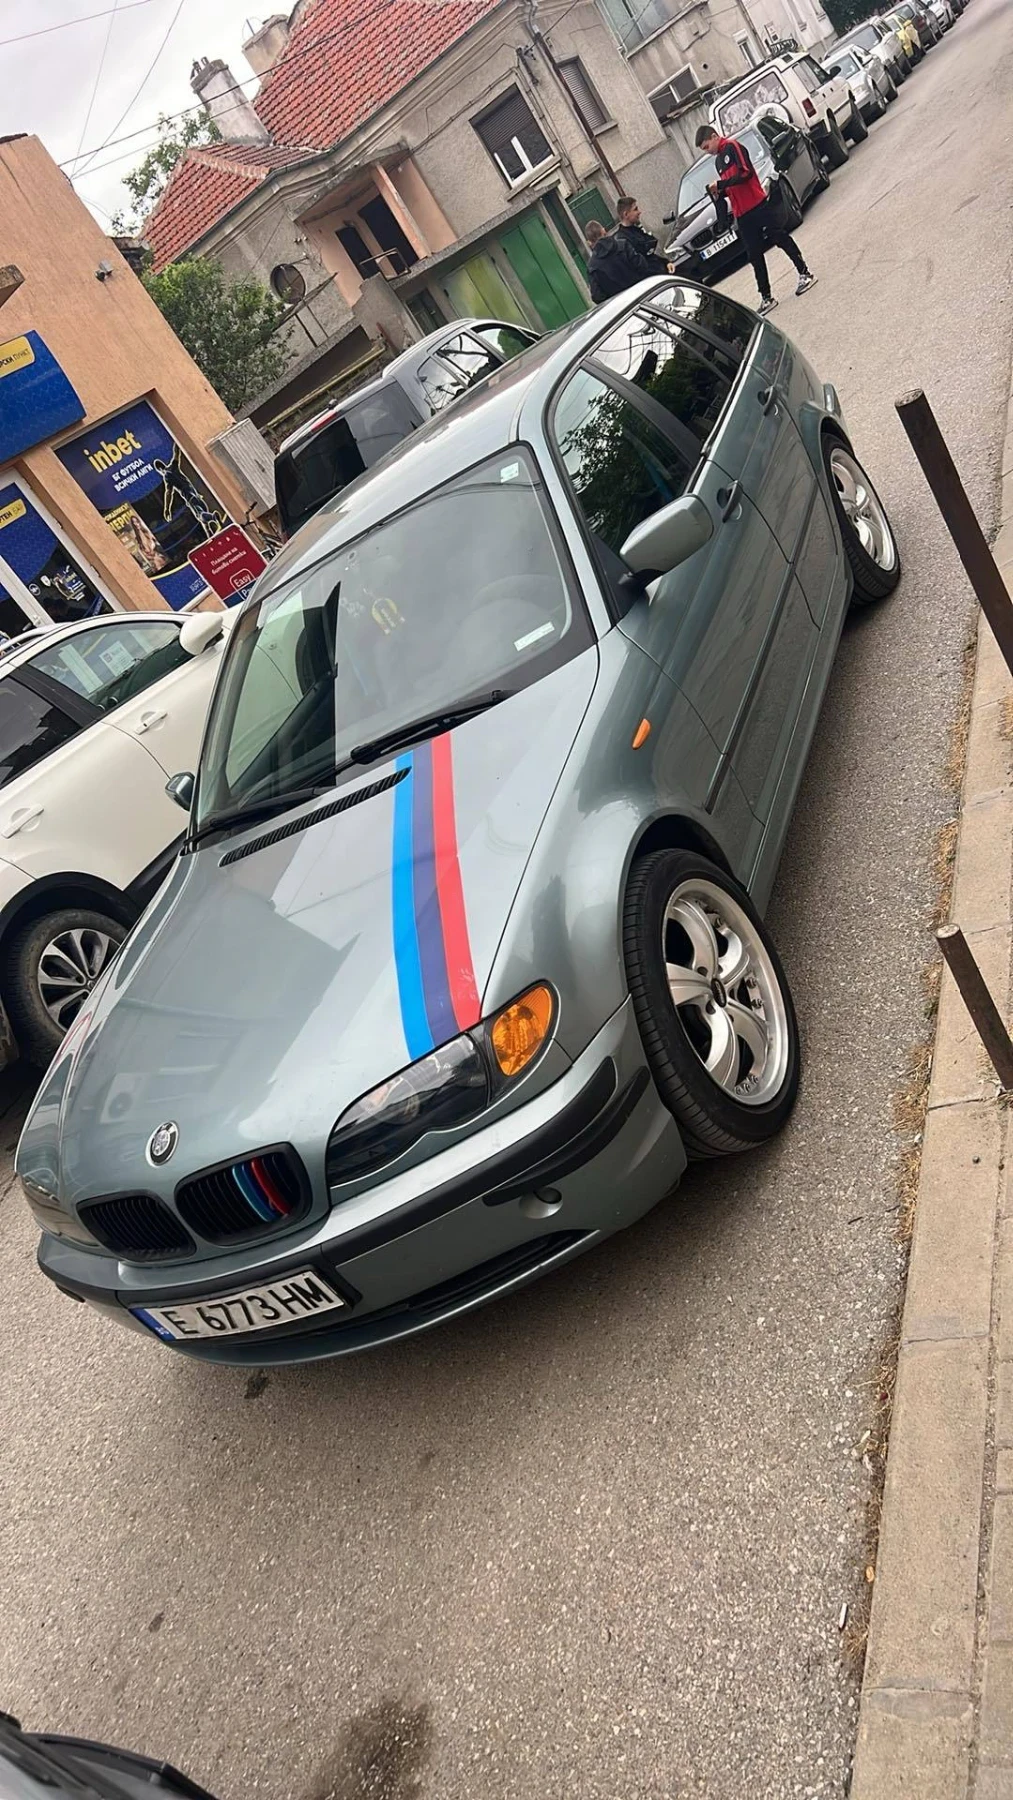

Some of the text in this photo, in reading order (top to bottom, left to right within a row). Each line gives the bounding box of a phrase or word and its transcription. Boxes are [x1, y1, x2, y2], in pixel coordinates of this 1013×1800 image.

[83, 429, 142, 473] inbet
[120, 458, 145, 477] ФУТБОЛ
[114, 474, 139, 492] ВСИЧКИ
[233, 573, 251, 587] Easy
[160, 1277, 334, 1335] E 6773 HM
